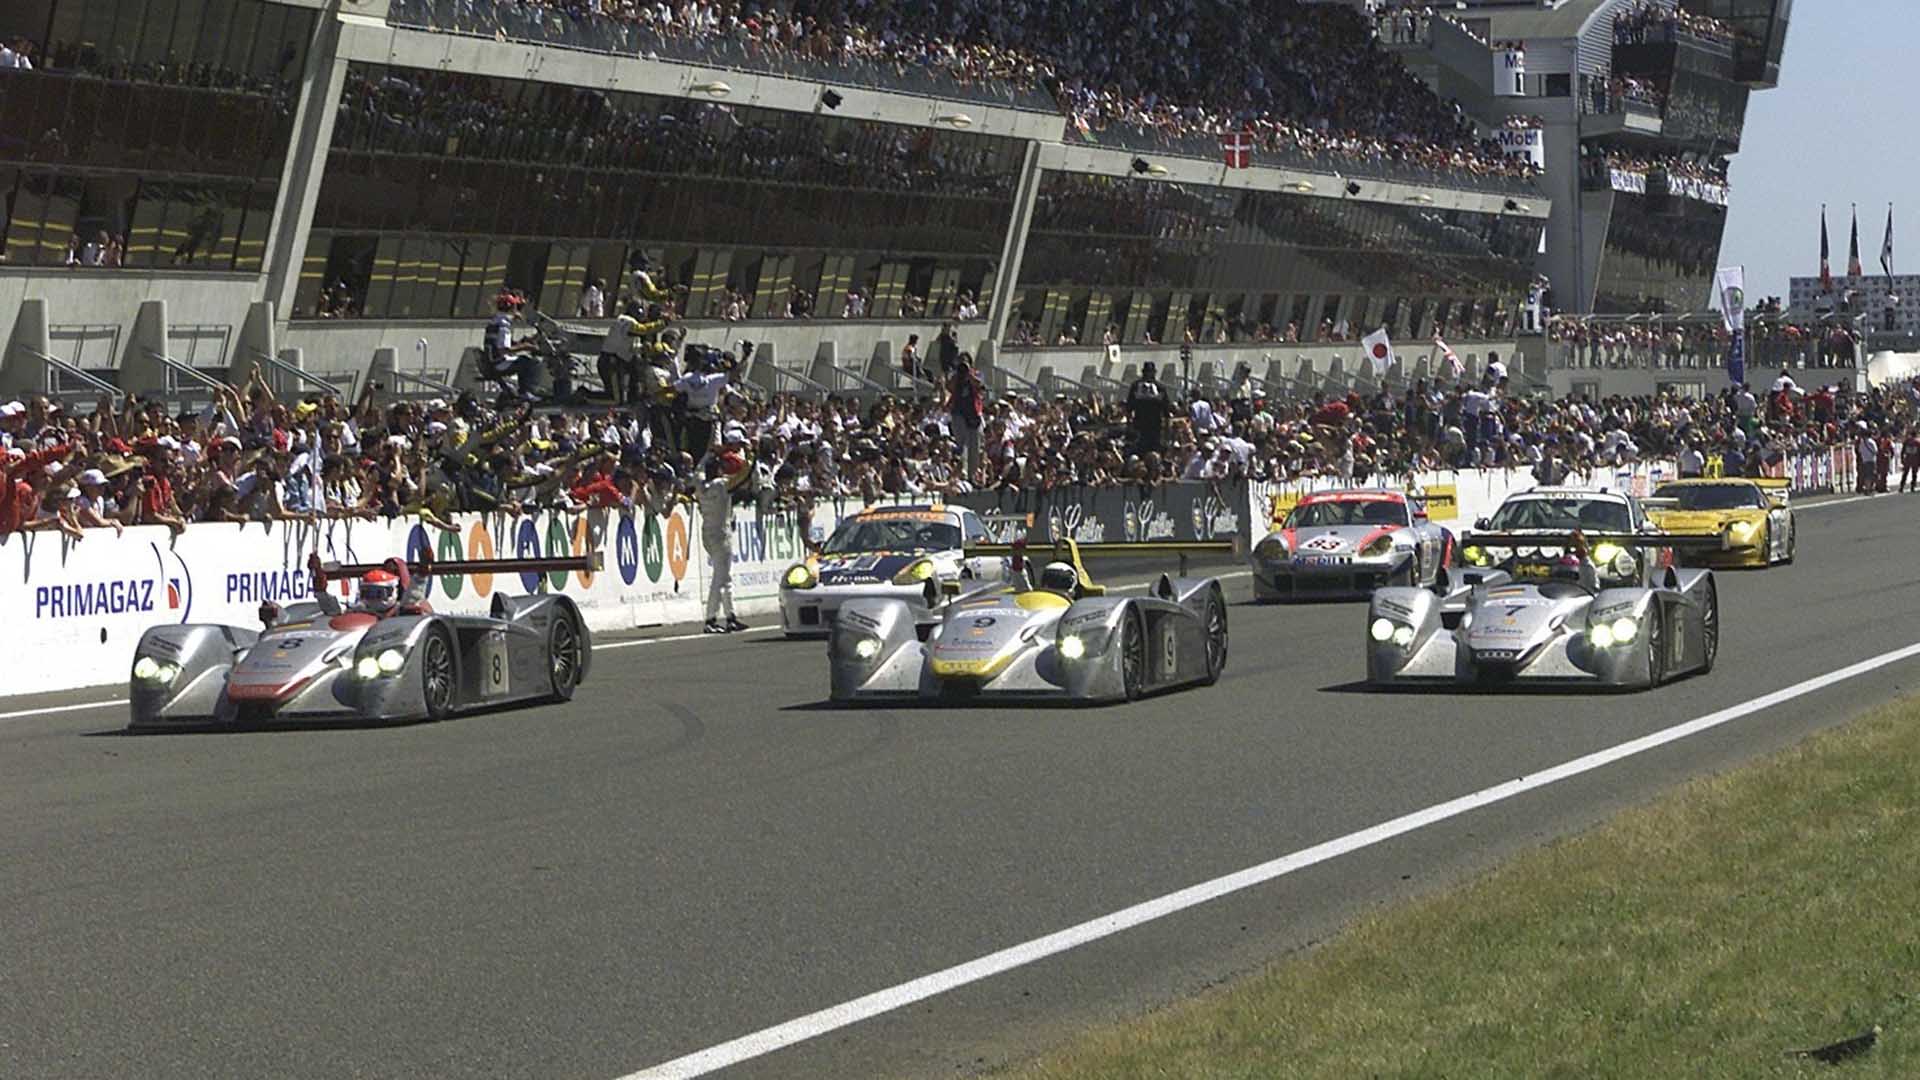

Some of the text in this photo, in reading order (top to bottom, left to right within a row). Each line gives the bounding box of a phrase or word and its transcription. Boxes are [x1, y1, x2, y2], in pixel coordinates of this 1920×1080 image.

[621, 529, 684, 567] MMA
[36, 579, 154, 619] PRIMAGAZ
[226, 568, 317, 604] PRIMAGA
[972, 616, 996, 628] 9
[1505, 604, 1527, 616] 7
[278, 638, 304, 649] 8
[493, 653, 501, 685] 8
